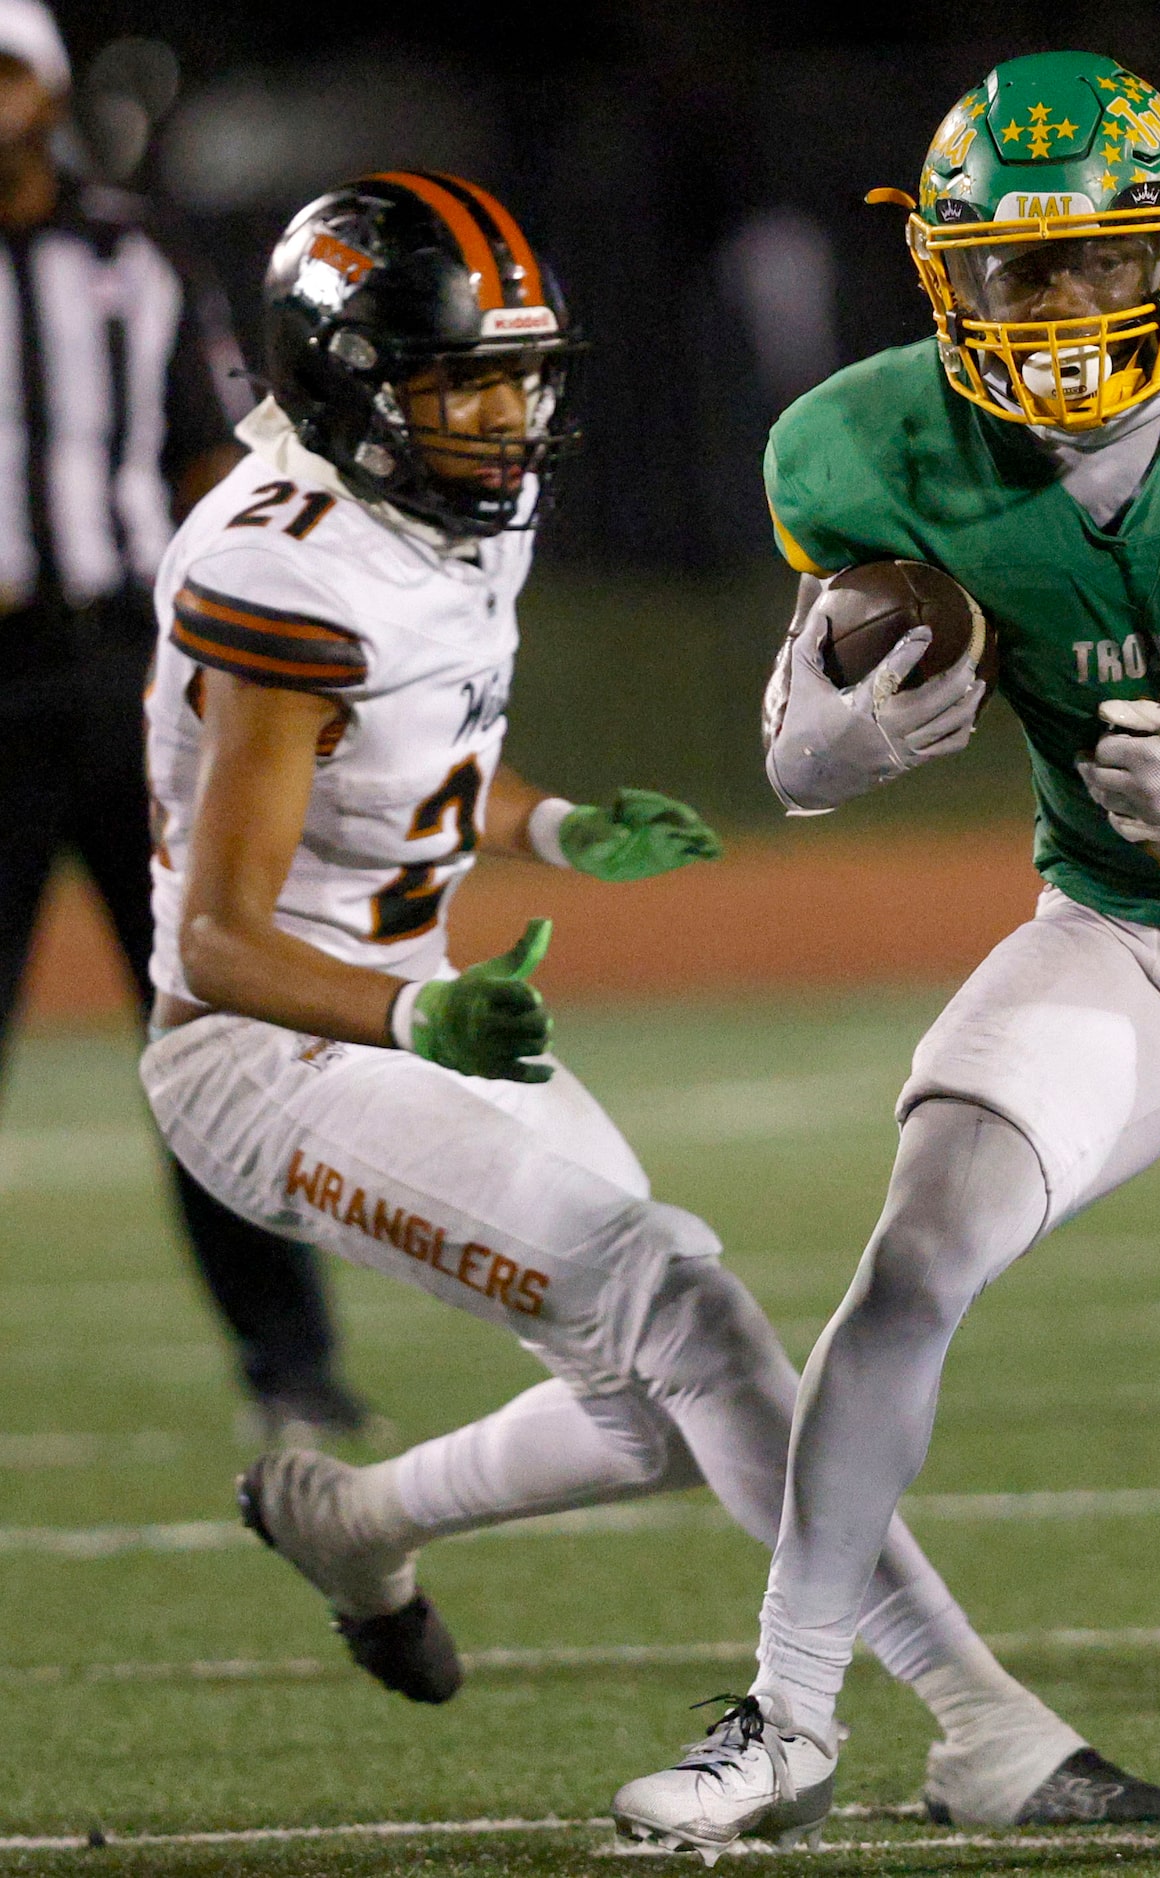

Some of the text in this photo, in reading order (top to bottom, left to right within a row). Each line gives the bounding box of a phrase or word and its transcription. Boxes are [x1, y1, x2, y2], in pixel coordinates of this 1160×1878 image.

[1017, 195, 1072, 216] TAAT
[225, 480, 336, 540] 21
[285, 1148, 551, 1318] WRANGLERS
